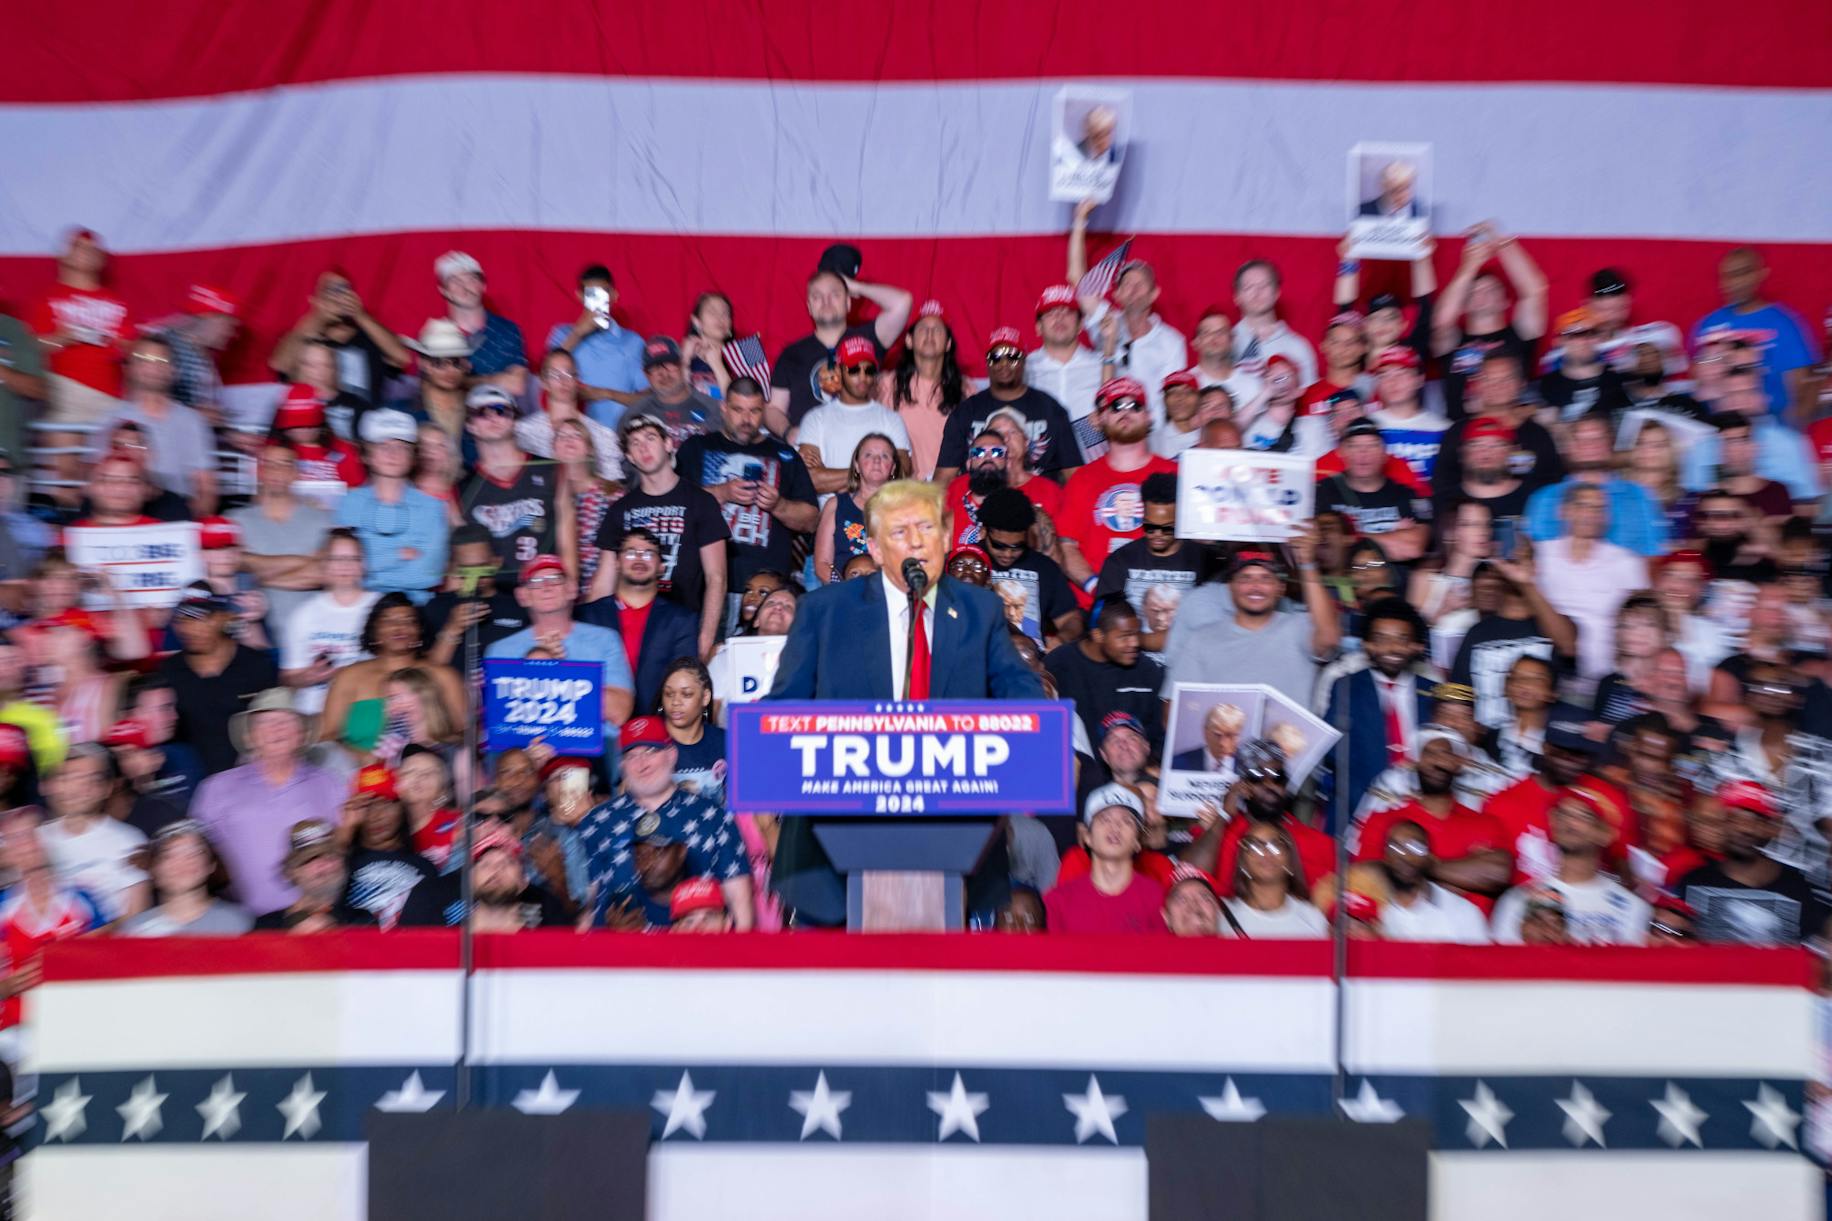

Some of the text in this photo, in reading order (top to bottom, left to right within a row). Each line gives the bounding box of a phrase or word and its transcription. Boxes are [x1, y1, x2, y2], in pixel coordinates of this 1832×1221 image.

[492, 676, 594, 702] TRUMP
[503, 699, 578, 725] 2024
[767, 716, 1034, 732] TEXT PENNSYLVANIA TO 88022
[789, 734, 1010, 777] TRUMP
[801, 780, 1000, 794] MAKE AMERICA GREAT AGAIN!
[875, 795, 925, 813] 2024
